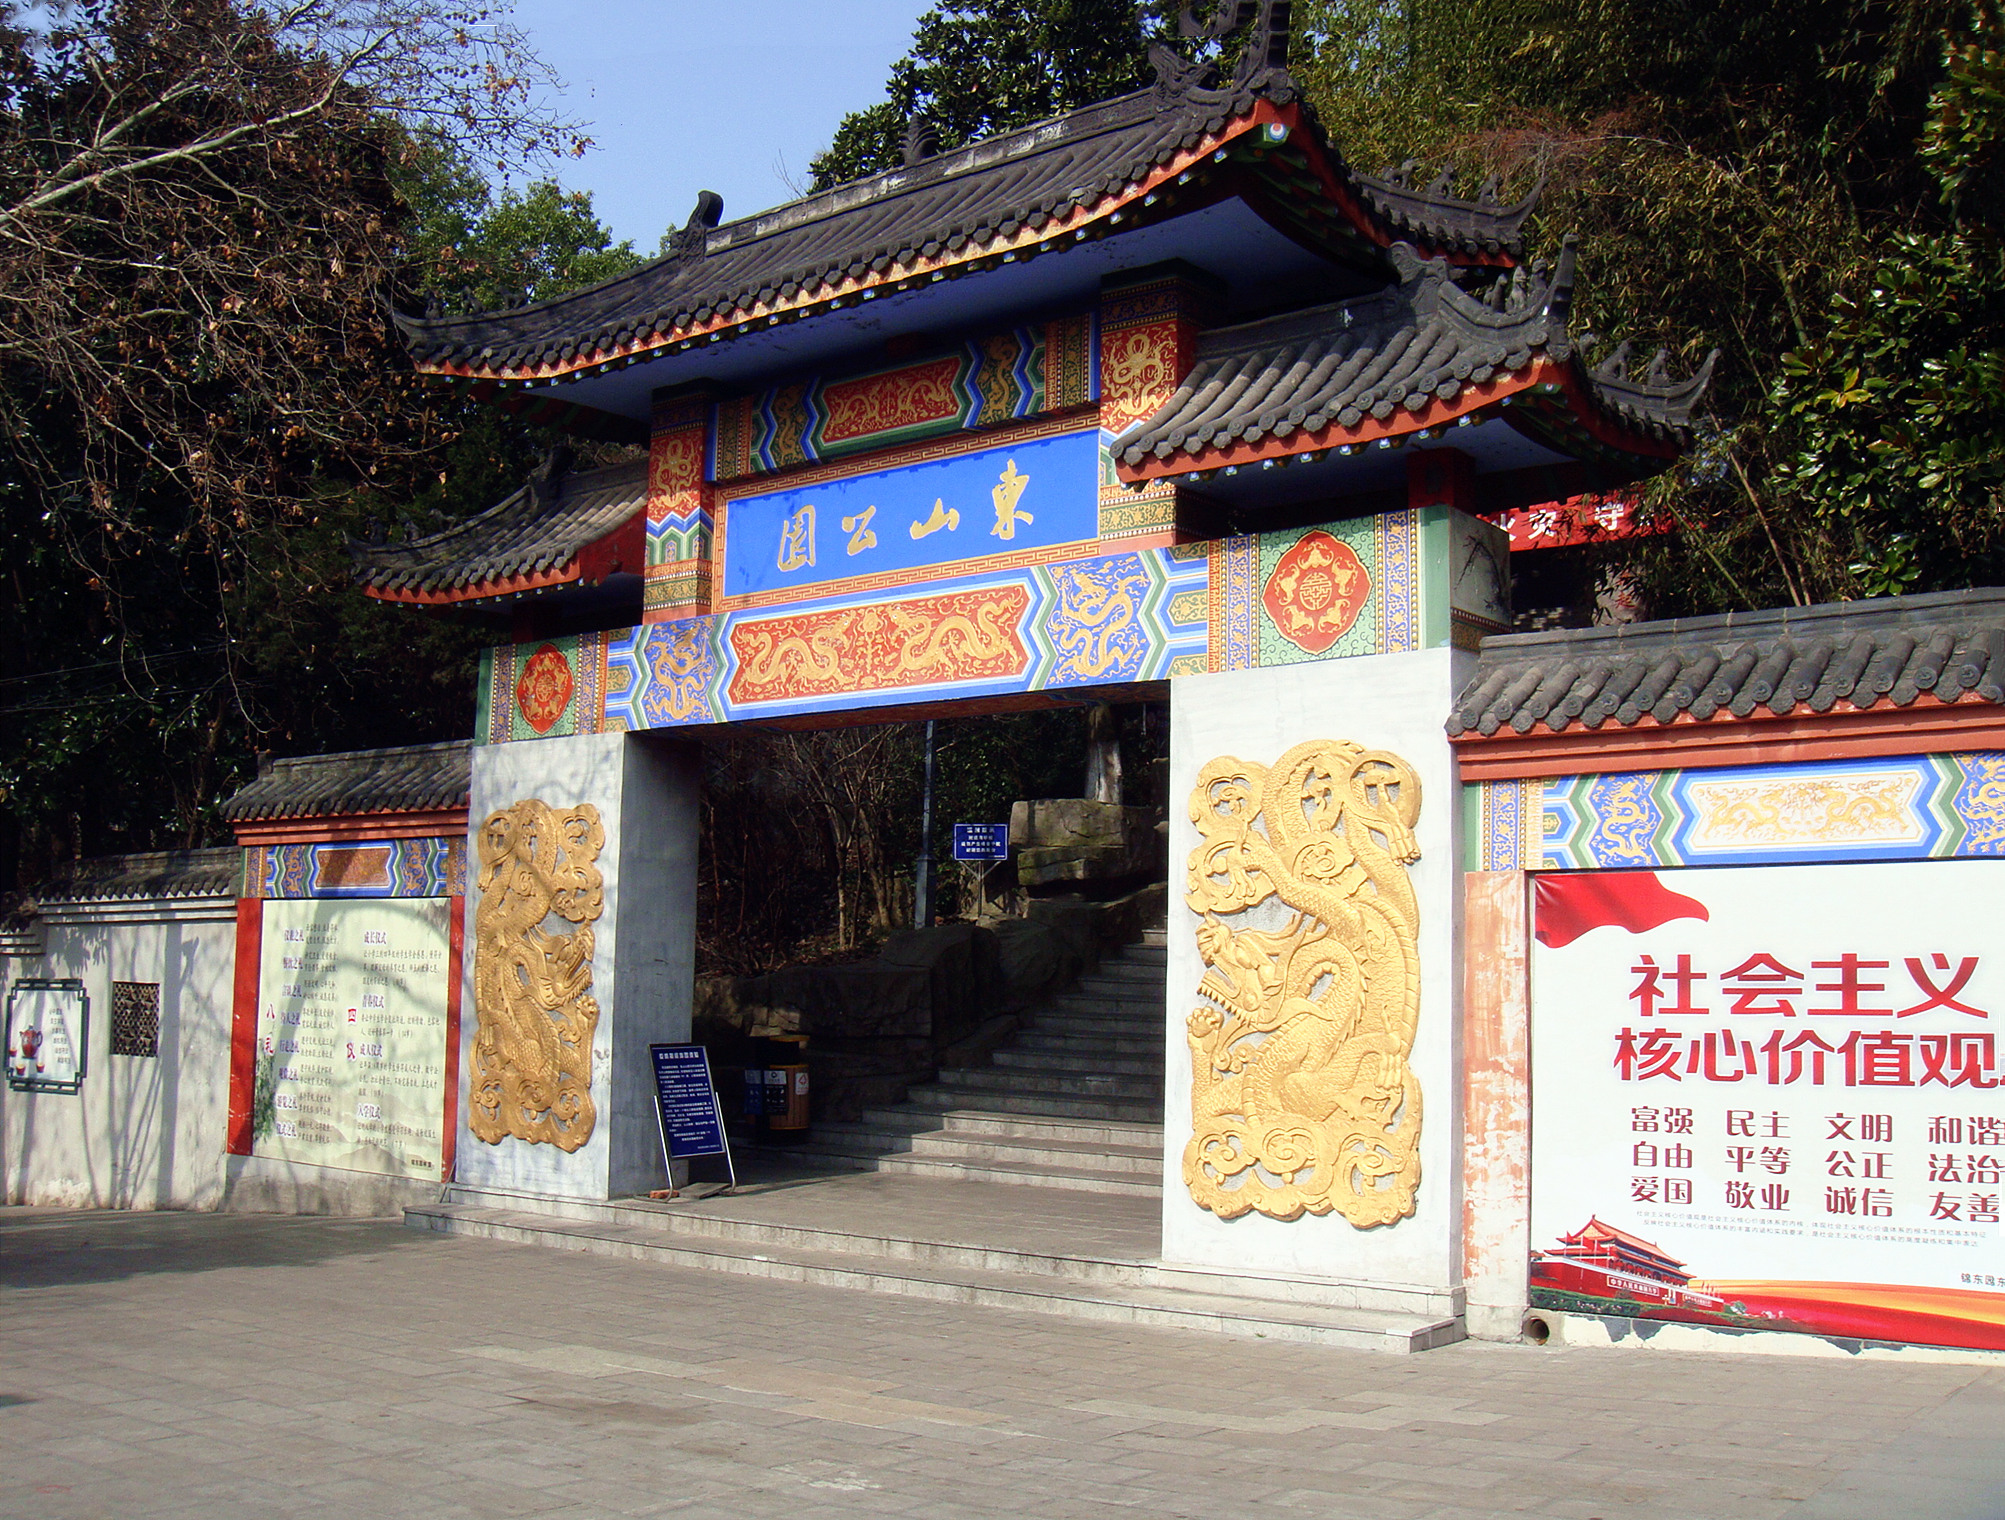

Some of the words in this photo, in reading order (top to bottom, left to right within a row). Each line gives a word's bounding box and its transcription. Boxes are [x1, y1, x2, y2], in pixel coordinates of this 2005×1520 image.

[1629, 952, 1989, 1019] 社会主义
[1613, 1027, 1999, 1089] 核心价值观
[1631, 1105, 1693, 1135] 富强
[1726, 1109, 1792, 1139] 民主
[1825, 1112, 1893, 1143] 文明
[1928, 1115, 2001, 1146] 和谐
[1633, 1140, 1693, 1169] 自由
[1725, 1146, 1792, 1175] 平等
[1825, 1150, 1894, 1180] 公正
[1928, 1153, 2000, 1184] 法治
[1631, 1176, 1693, 1205] 爱国
[1725, 1180, 1790, 1211] 敬业
[1824, 1186, 1893, 1217] 诚信
[1929, 1191, 2000, 1223] 友善
